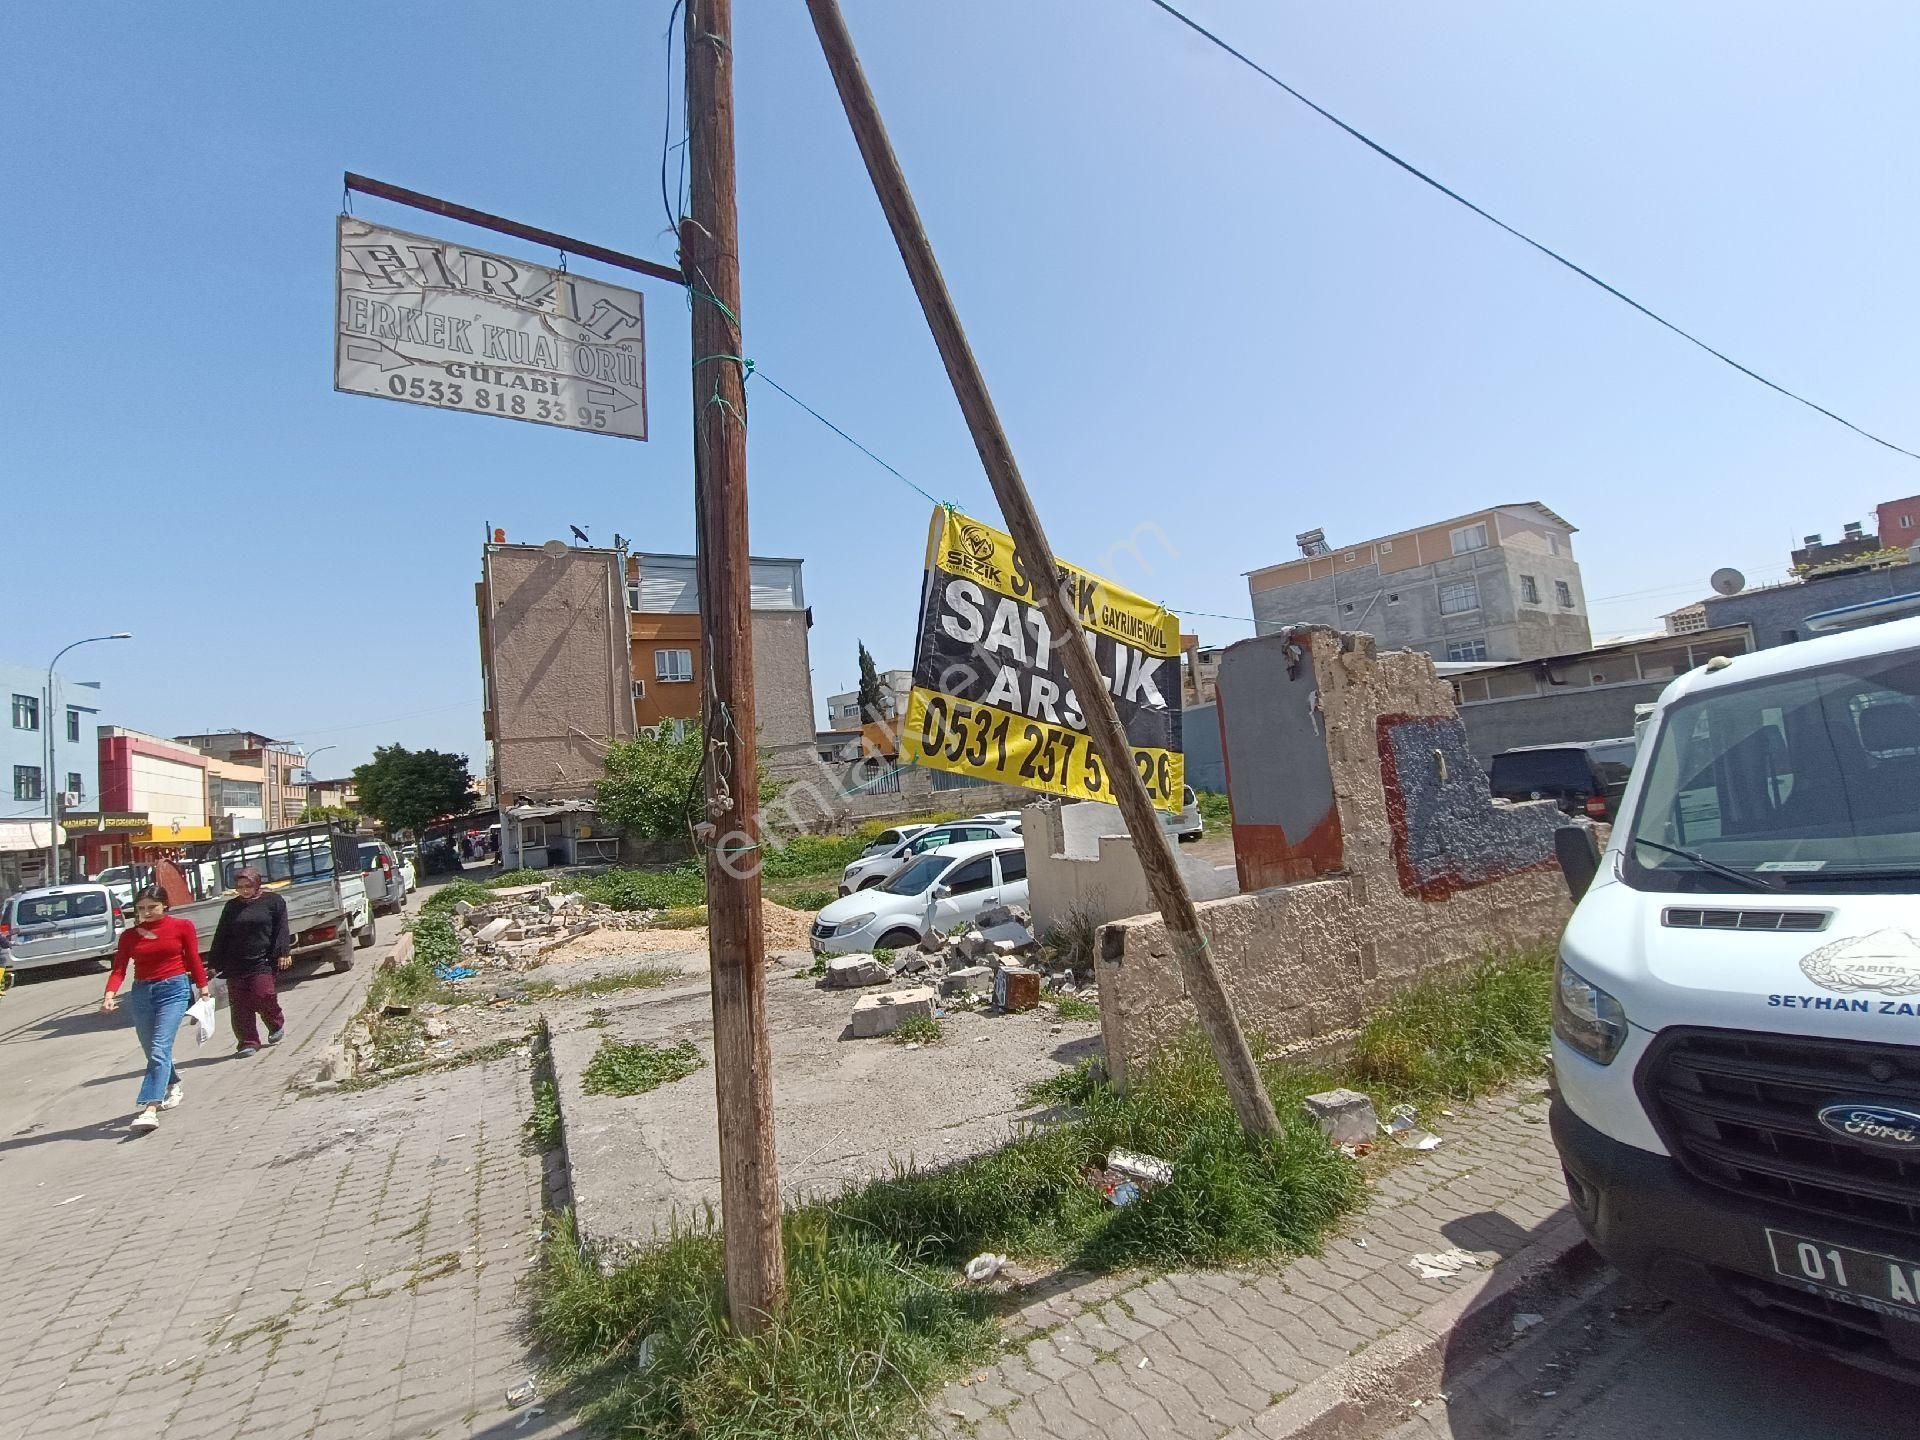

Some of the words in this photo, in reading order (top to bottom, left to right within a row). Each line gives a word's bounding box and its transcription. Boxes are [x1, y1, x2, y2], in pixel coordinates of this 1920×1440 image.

[343, 244, 640, 340] FIRAT
[347, 295, 472, 354] ERKEK
[388, 374, 463, 405] 0533
[475, 390, 526, 415] 818
[536, 399, 568, 422] 33
[577, 406, 607, 428] 95
[941, 579, 1168, 709] SATIK
[1102, 605, 1167, 648] GAYRİMENKUL
[986, 665, 1088, 730] ARS
[921, 697, 1010, 771] 0531
[1019, 724, 1075, 786] 257
[1844, 964, 1906, 975] ZABITA
[1767, 994, 1869, 1013] SEYHAN
[1878, 1001, 1920, 1017] ZA
[1844, 1110, 1916, 1142] Ford
[1797, 1242, 1848, 1287] 01
[1890, 1264, 1920, 1305] A
